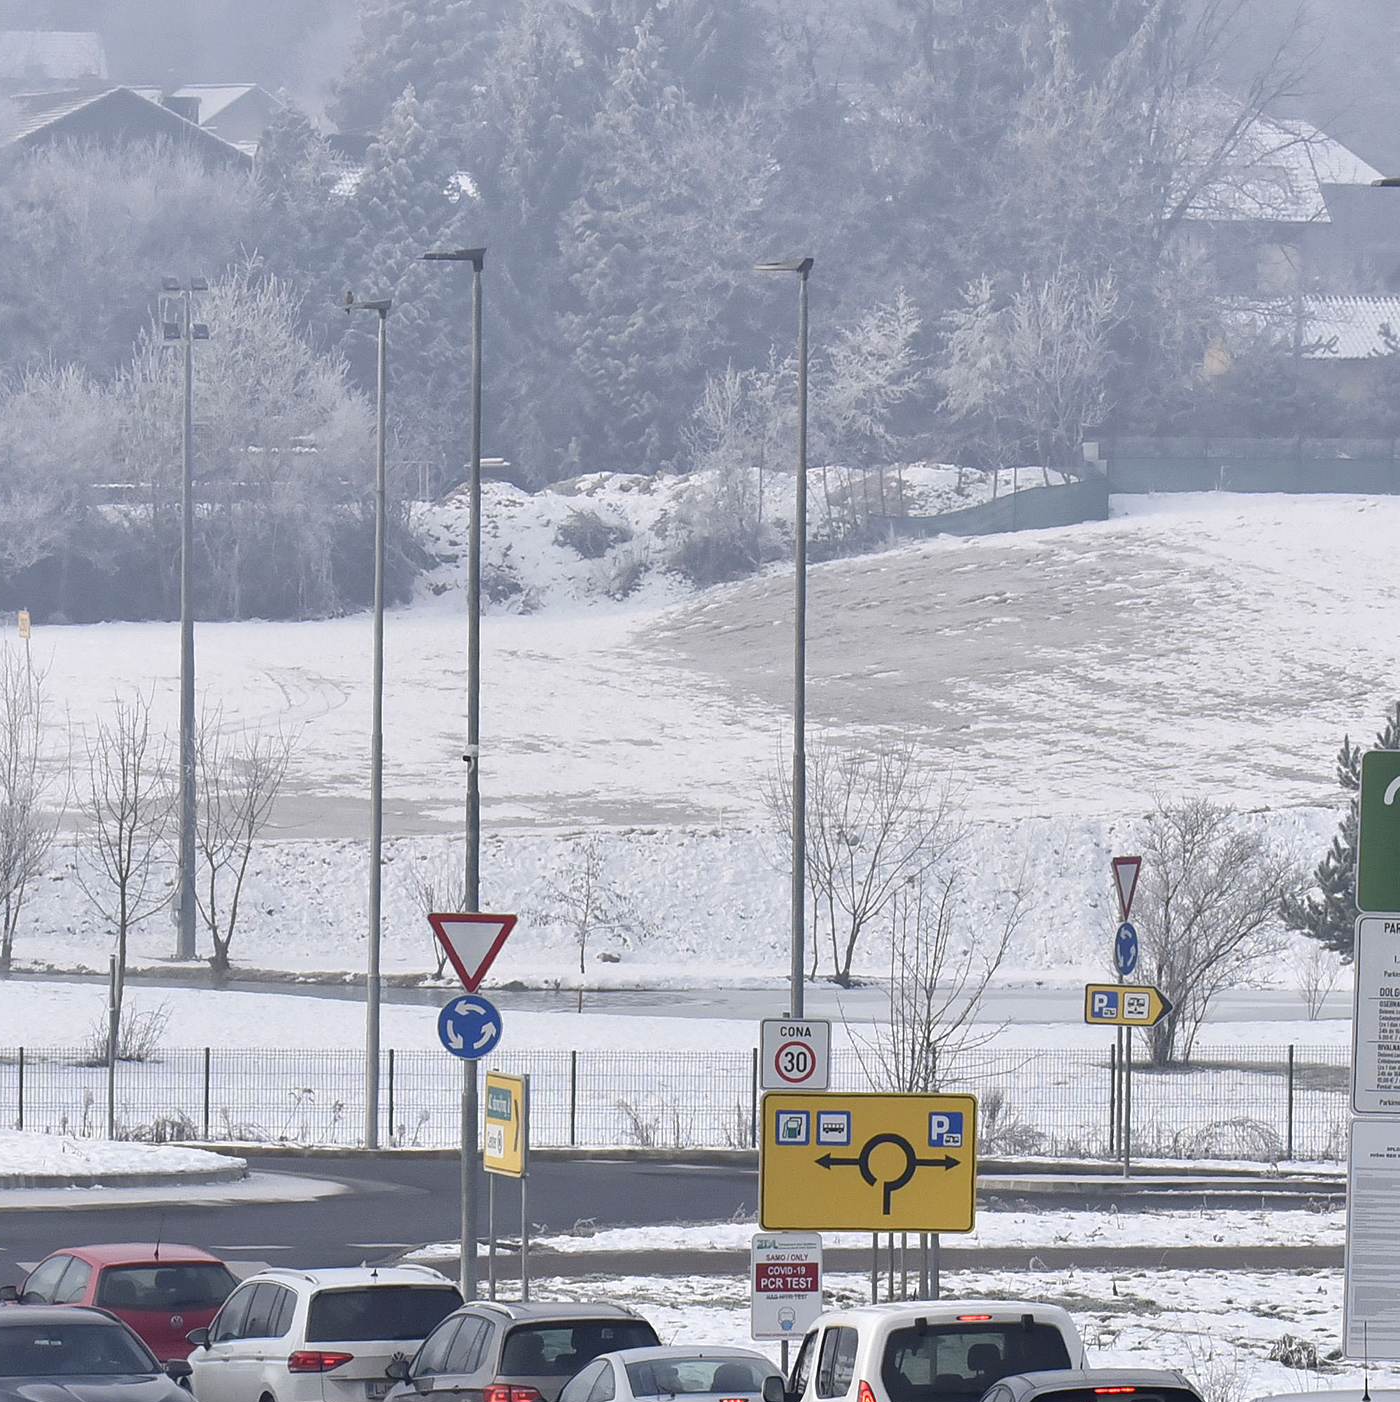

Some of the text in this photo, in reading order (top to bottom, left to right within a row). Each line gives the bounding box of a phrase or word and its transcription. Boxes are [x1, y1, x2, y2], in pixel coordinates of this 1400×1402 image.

[780, 1025, 812, 1038] CONA
[783, 1051, 807, 1073] 30
[932, 1115, 950, 1140] P
[761, 1277, 813, 1289] PCR TEST
